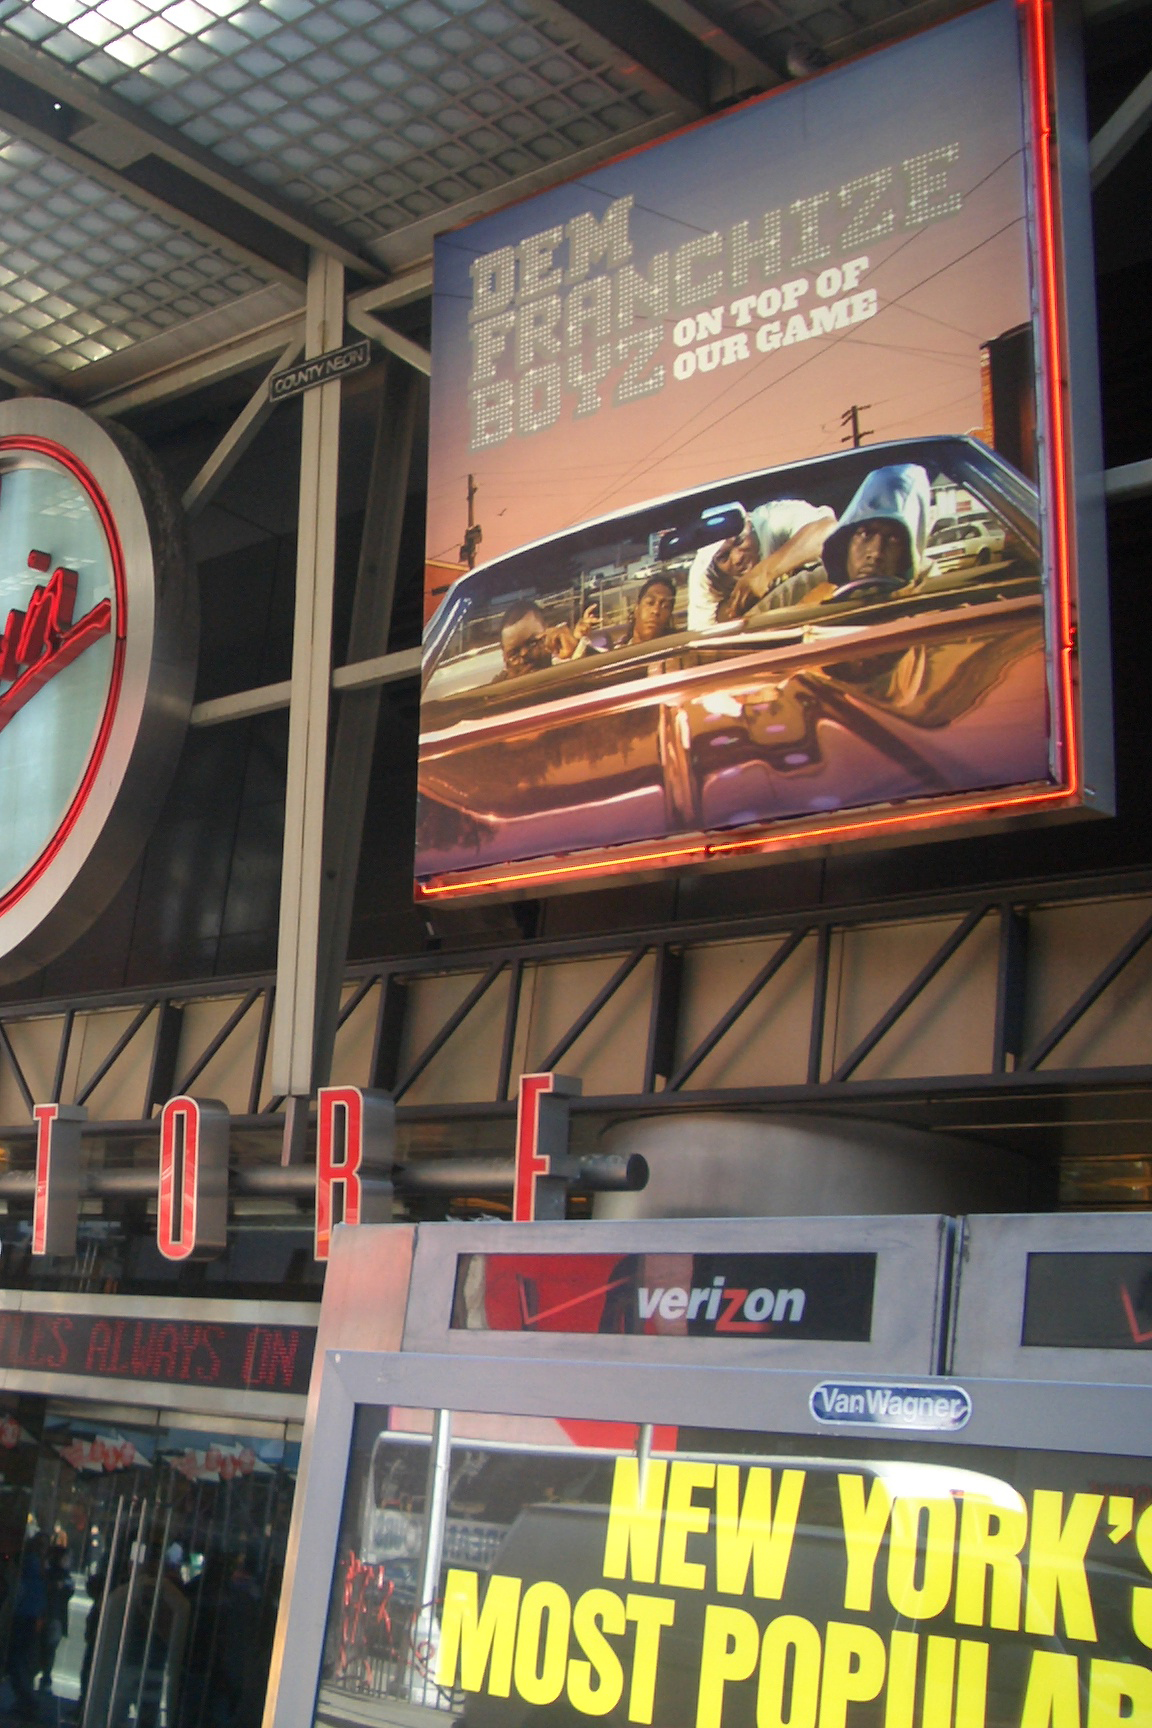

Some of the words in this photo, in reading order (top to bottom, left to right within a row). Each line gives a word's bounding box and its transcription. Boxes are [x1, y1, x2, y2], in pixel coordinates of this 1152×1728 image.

[469, 194, 636, 321] DEM
[470, 141, 964, 388] FRANCHIZE
[673, 306, 724, 347] ON
[730, 277, 809, 327] TOP
[816, 255, 869, 298] OF
[275, 363, 324, 394] COUNTY
[326, 347, 364, 374] NEON
[468, 324, 667, 452] BOYZ
[673, 332, 749, 381] OUR
[756, 288, 877, 352] GAME
[84, 1319, 227, 1383] ALWAYS
[241, 1327, 300, 1388] ON
[637, 1275, 806, 1333] verizon
[602, 1456, 806, 1601] NEW
[434, 1568, 675, 1728] MOST
